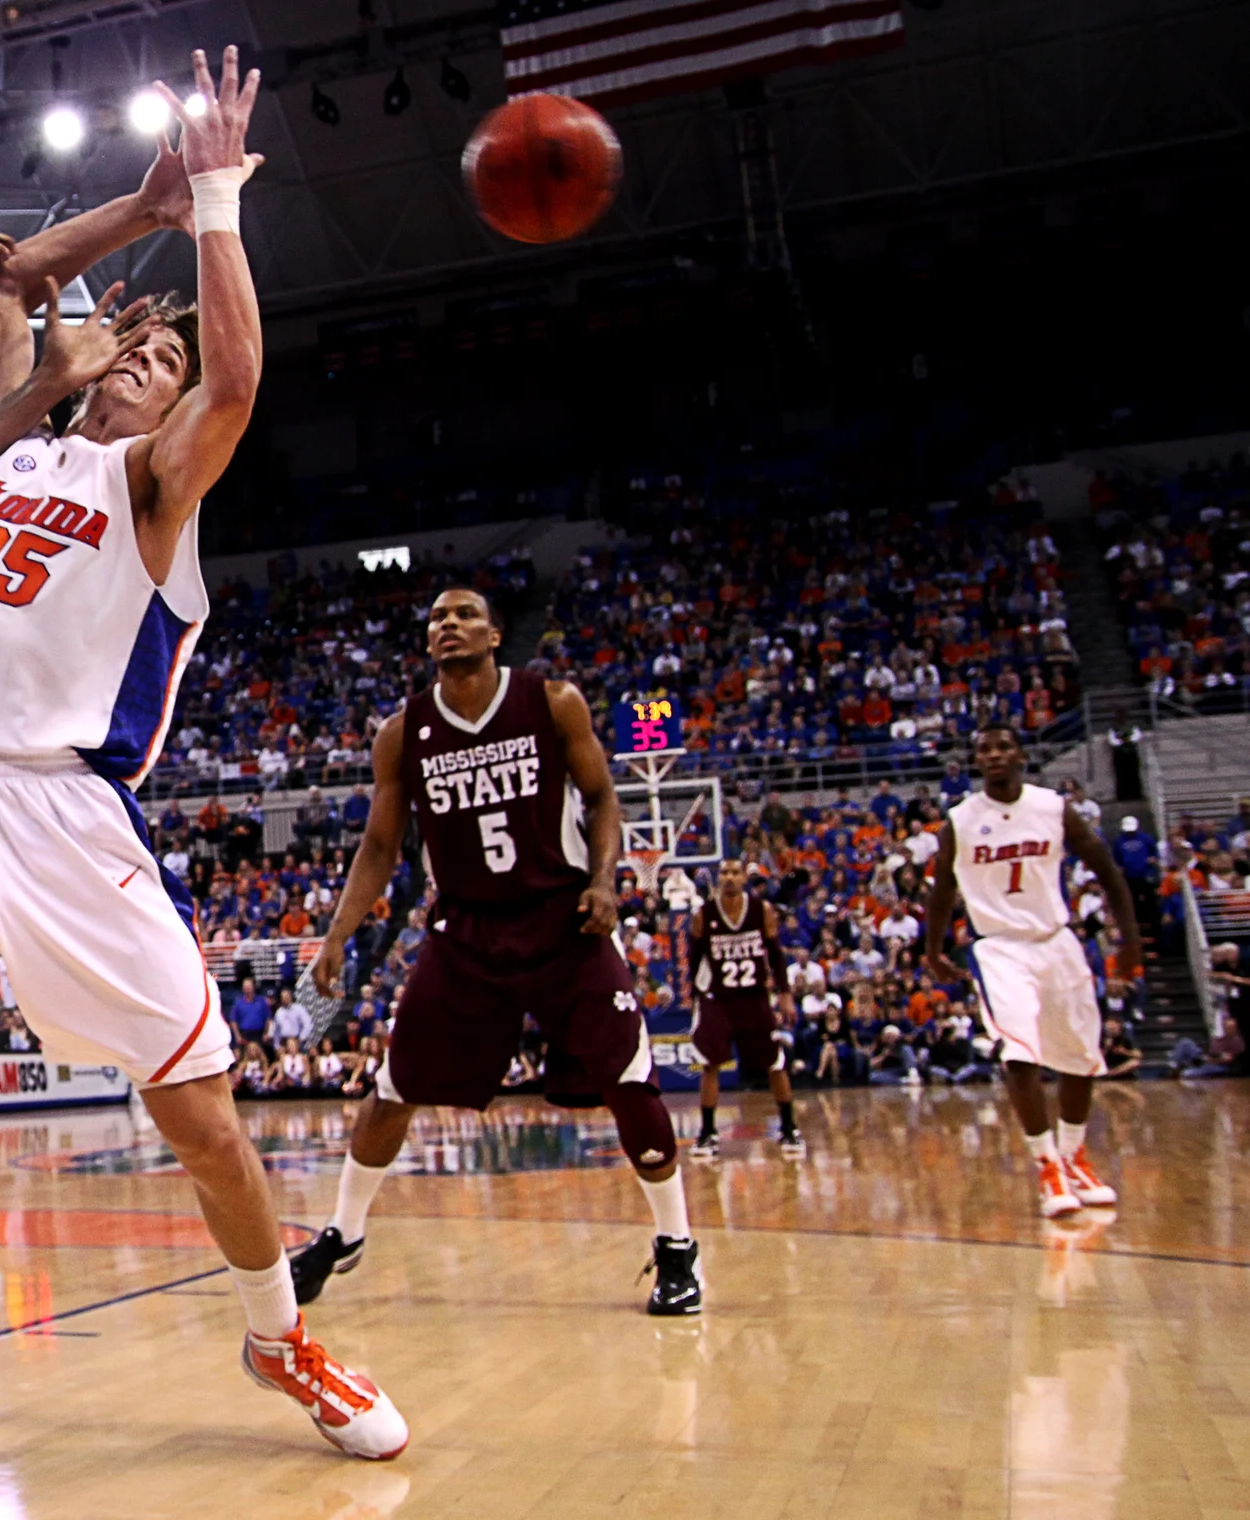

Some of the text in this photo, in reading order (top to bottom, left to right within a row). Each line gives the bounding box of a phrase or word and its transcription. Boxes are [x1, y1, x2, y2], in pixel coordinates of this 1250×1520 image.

[631, 719, 668, 751] 35
[420, 734, 538, 778] MISSISSIPPI
[425, 757, 540, 815] STATE
[477, 811, 517, 874] 5
[1006, 861, 1023, 896] 1
[710, 936, 765, 960] STATE
[721, 959, 757, 988] 22
